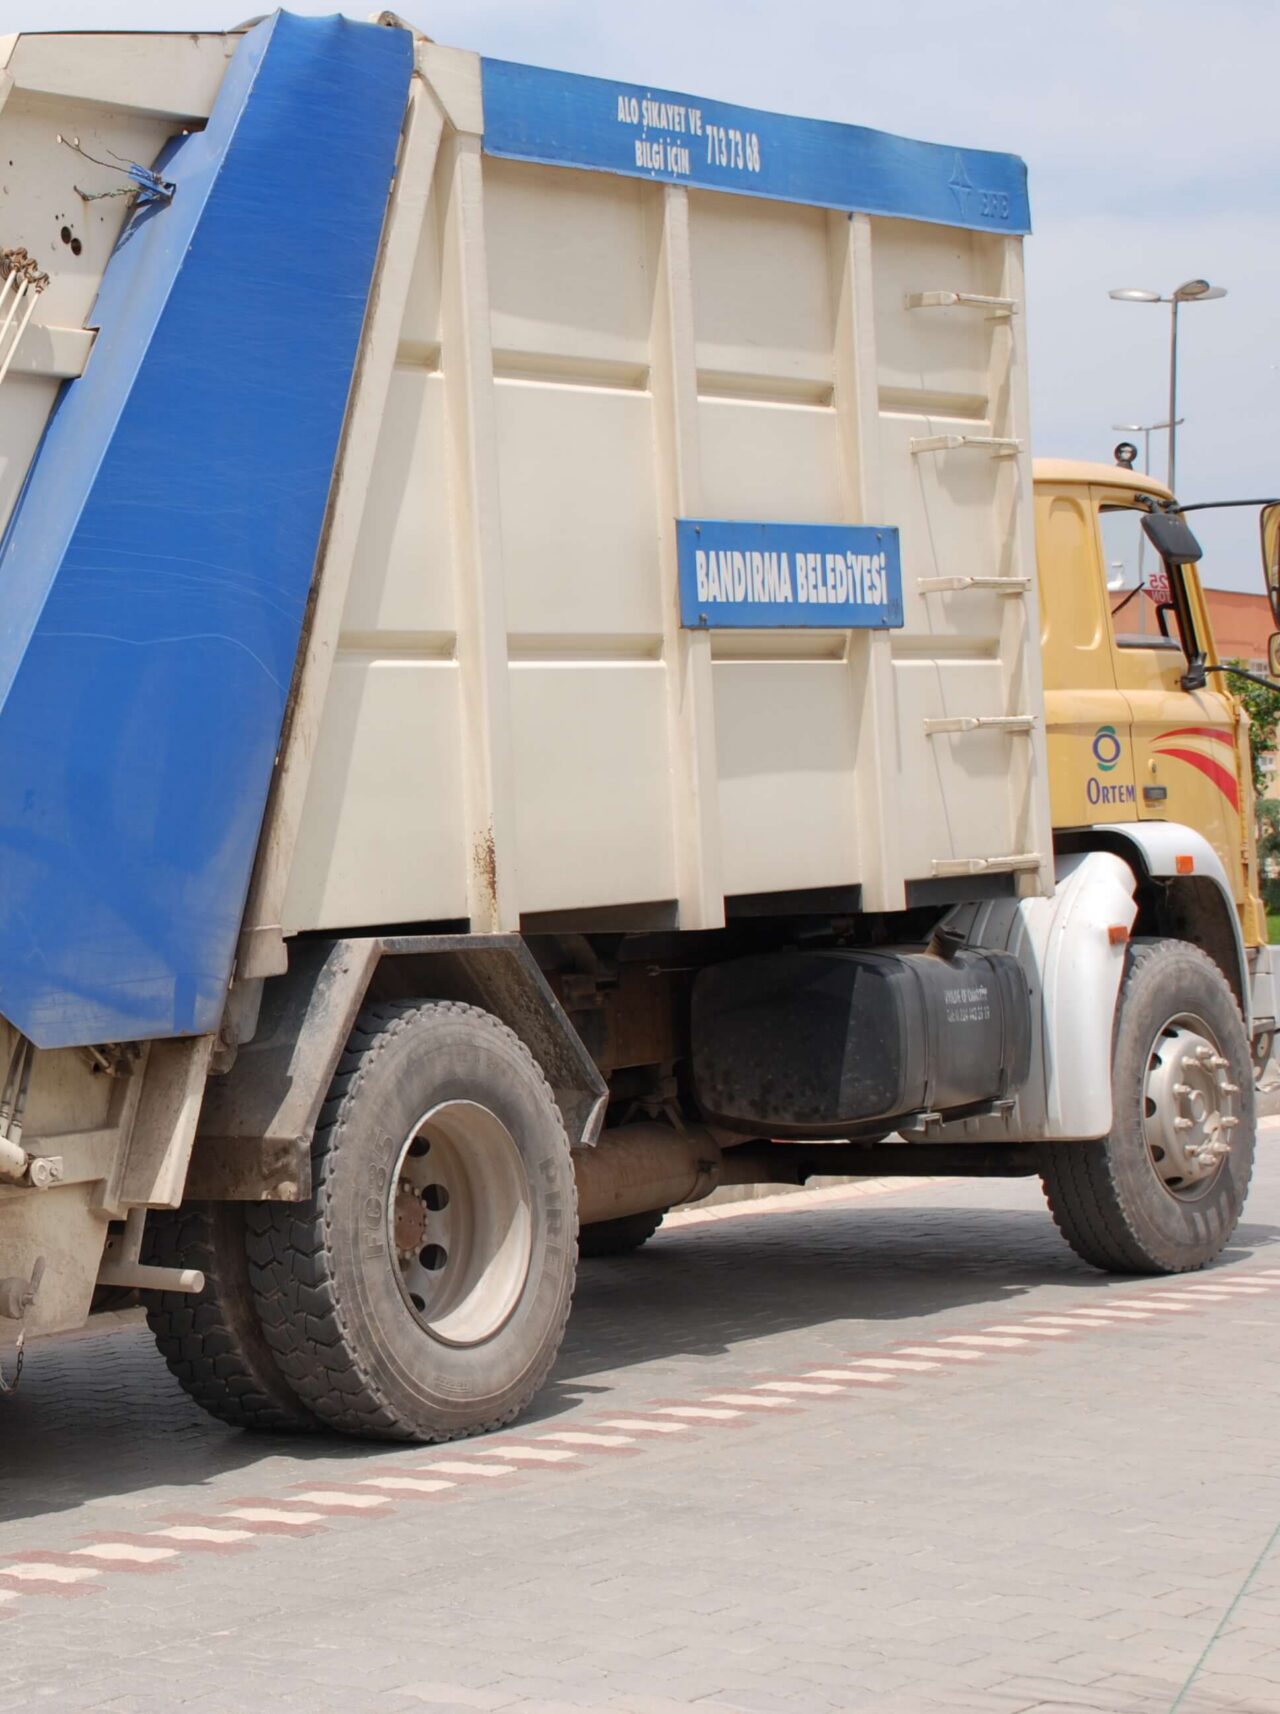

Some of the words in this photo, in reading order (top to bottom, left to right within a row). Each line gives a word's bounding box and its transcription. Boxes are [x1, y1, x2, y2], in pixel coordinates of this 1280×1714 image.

[618, 95, 639, 125] ALO
[642, 92, 686, 133] ŞİKAYET
[688, 108, 702, 137] VE
[667, 137, 690, 177] İÇİN
[706, 124, 727, 167] 713
[728, 128, 744, 170] 73
[746, 132, 760, 173] 68
[695, 550, 793, 604] BANDIRMA
[795, 550, 888, 606] BELEDİYESİ
